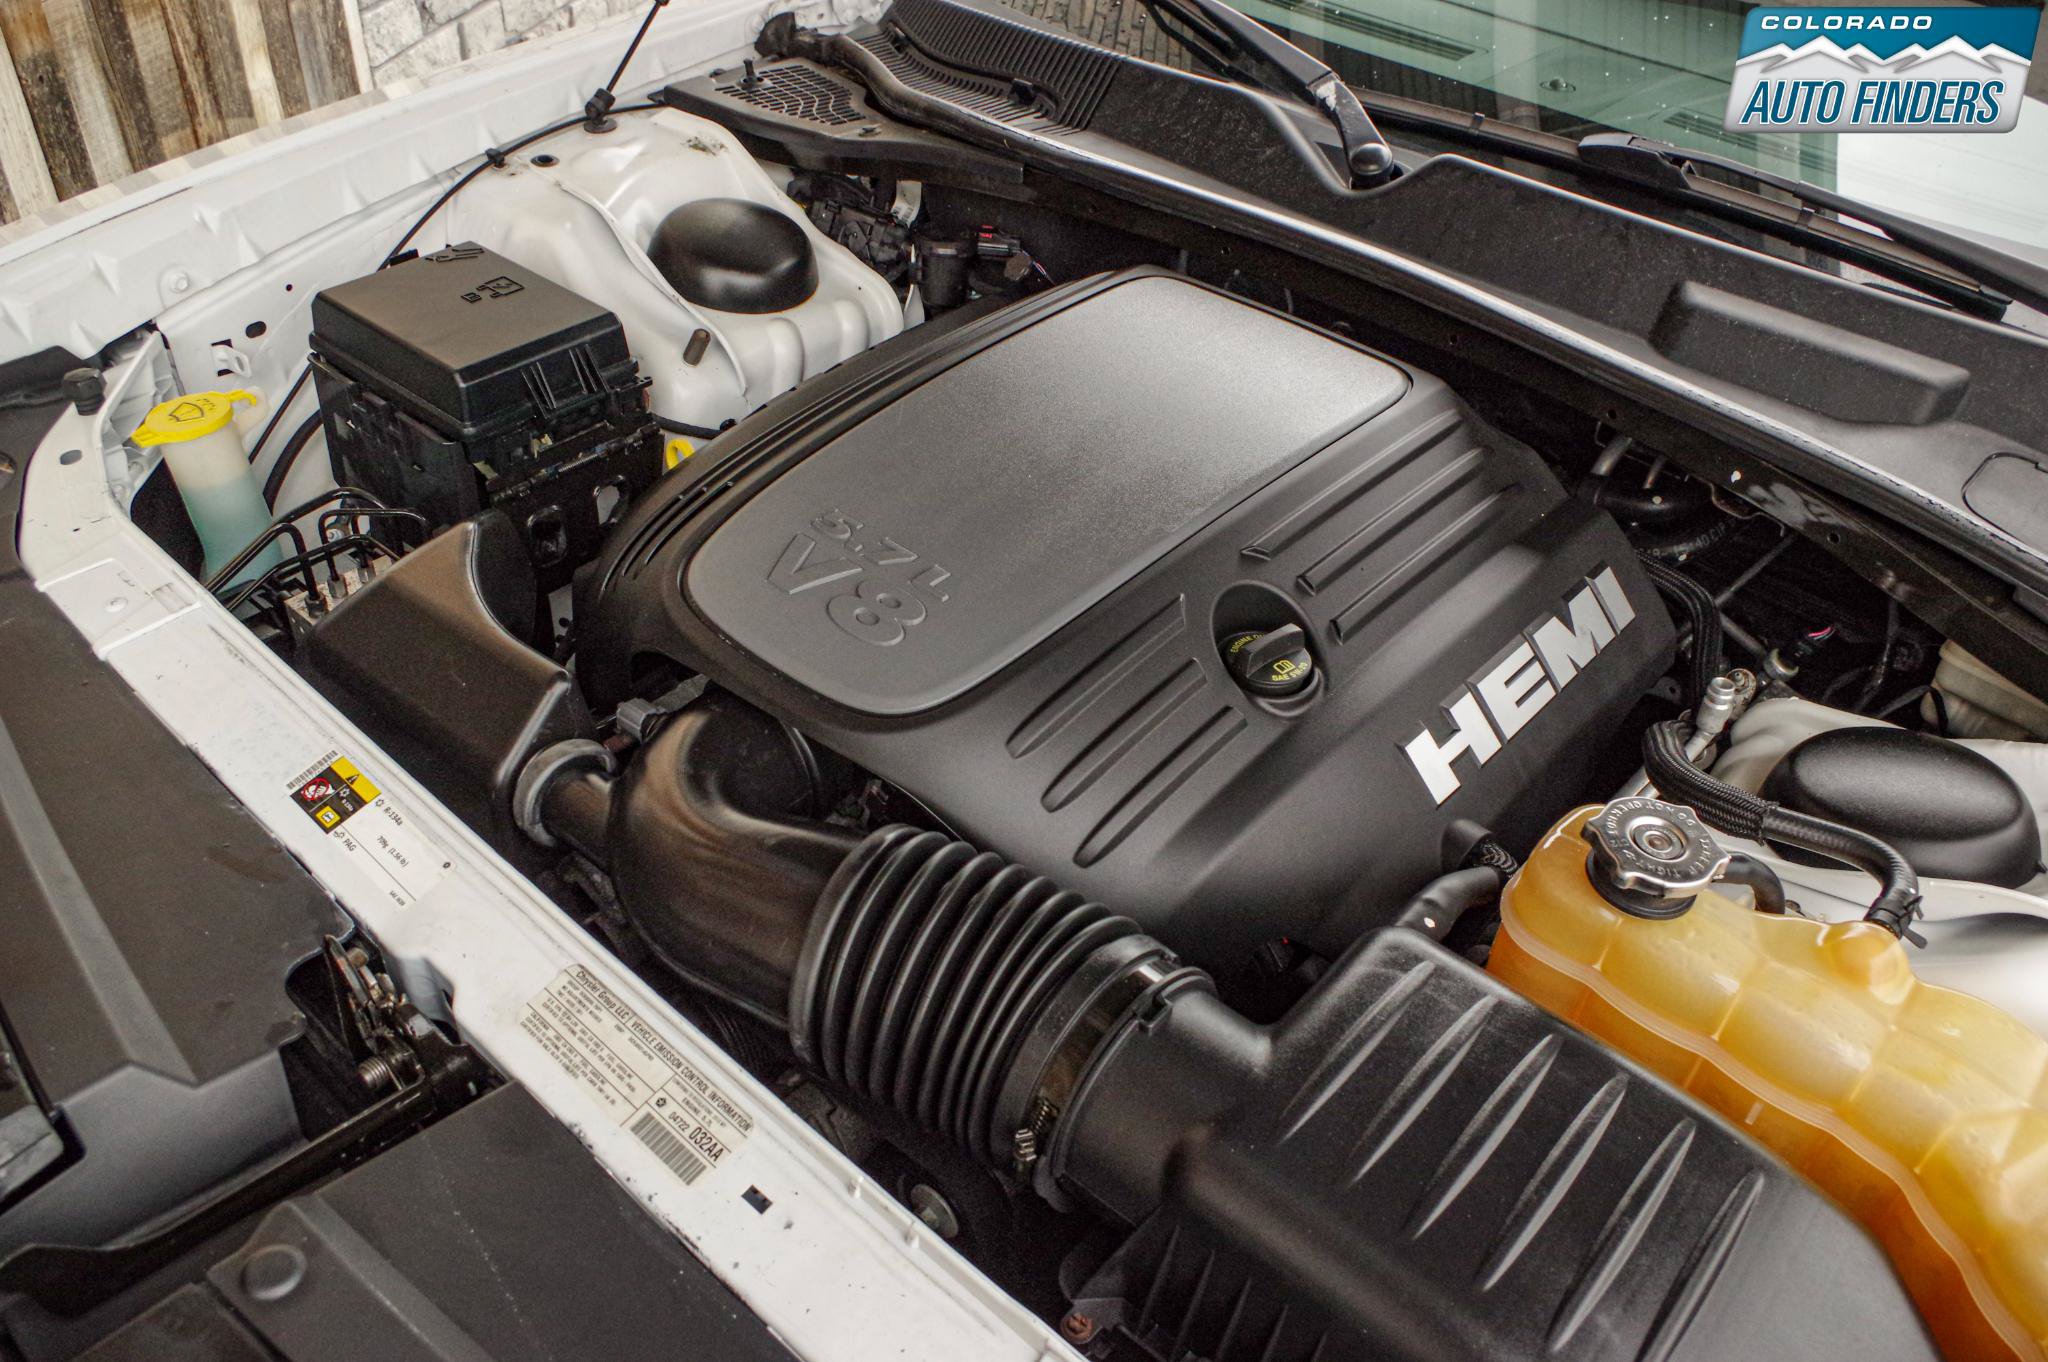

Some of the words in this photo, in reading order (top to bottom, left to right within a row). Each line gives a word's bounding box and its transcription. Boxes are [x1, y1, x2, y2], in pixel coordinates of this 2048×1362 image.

[808, 508, 951, 602] 5.7L
[765, 532, 927, 647] V8
[1271, 673, 1290, 681] SAE
[1401, 566, 1636, 806] HEMI
[384, 806, 403, 826] R-134a
[1645, 800, 1675, 815] NOT
[1678, 812, 1696, 827] DO
[343, 838, 357, 852] PAG
[576, 970, 600, 993] Chrysler
[597, 990, 617, 1009] Group
[614, 1006, 630, 1020] LLC
[631, 1020, 657, 1046] VEHICLE
[653, 1041, 683, 1070] EMISSION
[680, 1066, 710, 1095] CONTROL
[707, 1091, 752, 1131] INFORMATION
[668, 1111, 690, 1132] 04722
[688, 1126, 725, 1162] 032AA
